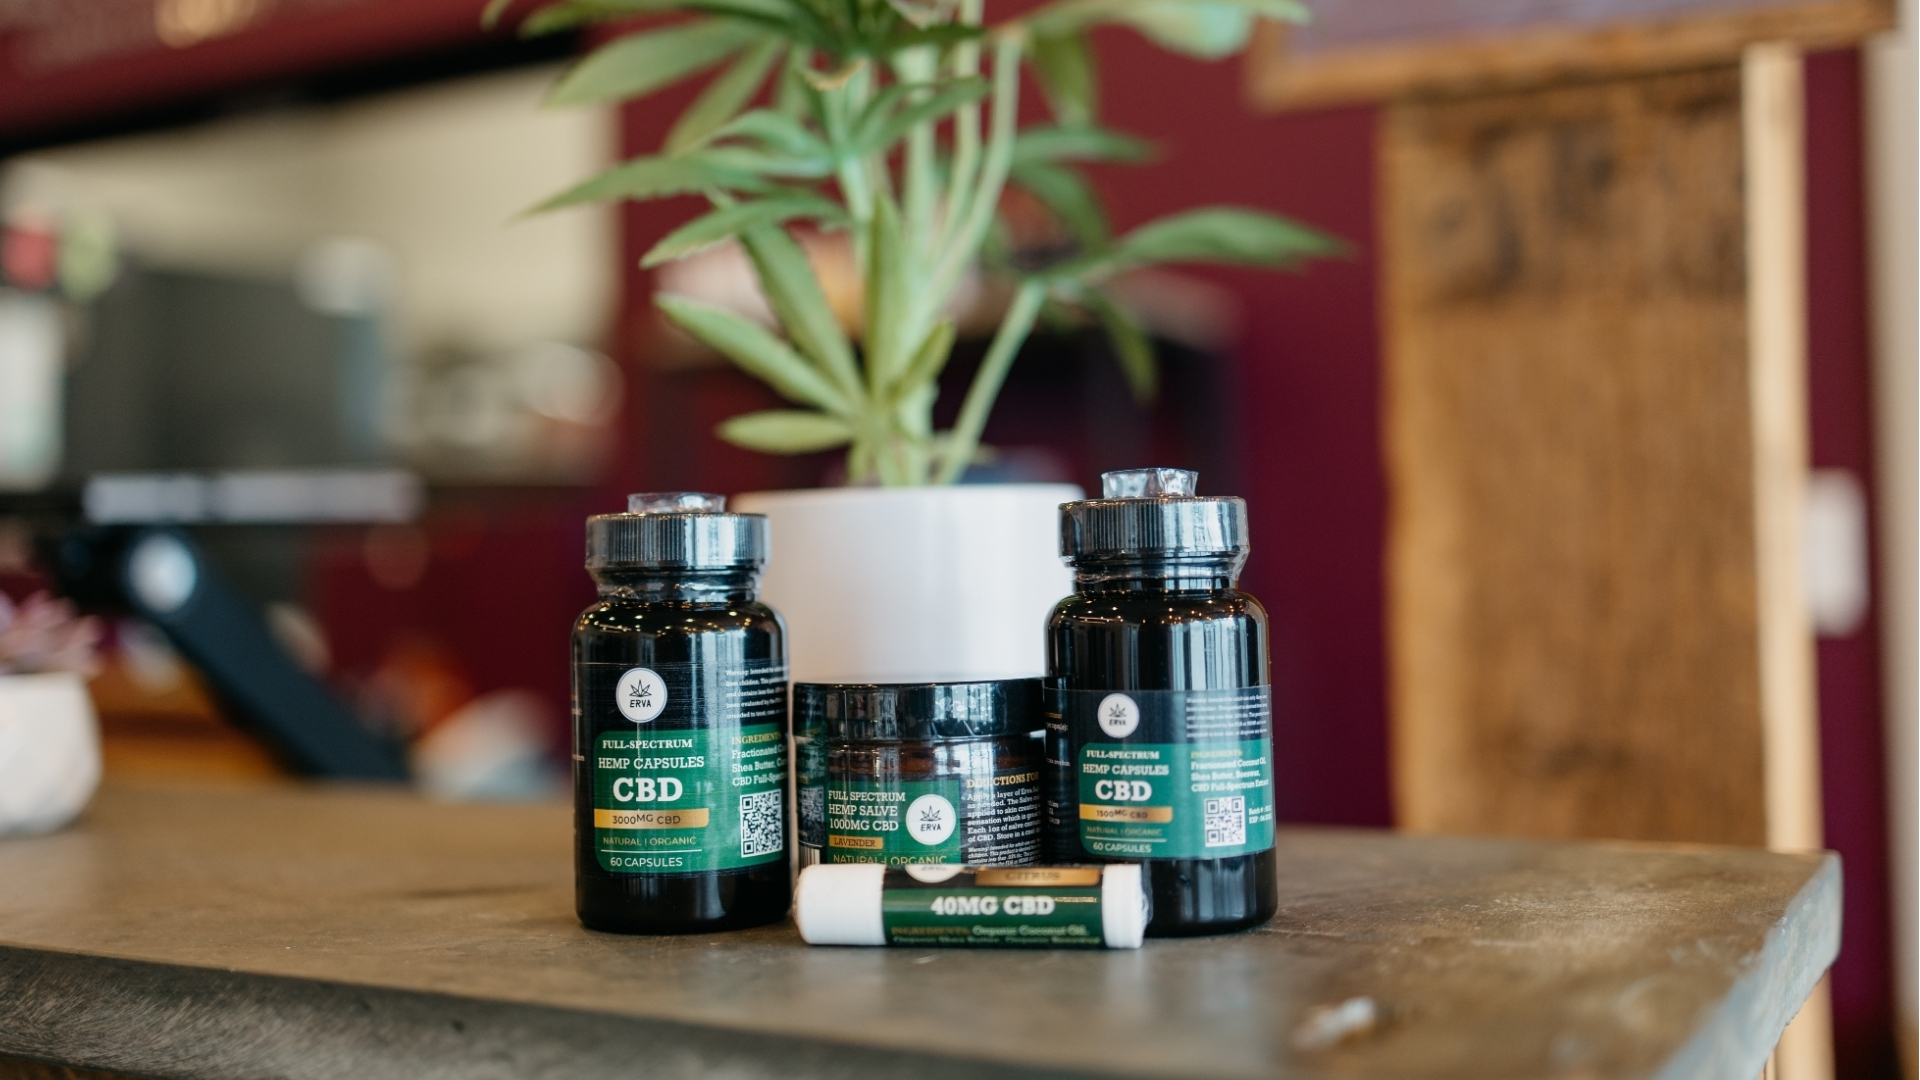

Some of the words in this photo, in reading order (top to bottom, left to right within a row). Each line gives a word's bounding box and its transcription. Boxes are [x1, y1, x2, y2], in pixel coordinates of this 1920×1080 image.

[630, 700, 652, 708] ERVA
[602, 739, 693, 749] FULL-SPECTRUM
[732, 744, 777, 759] Fractionated
[1086, 750, 1160, 760] FULL-SPECTRUM
[598, 758, 630, 769] HEMP
[634, 756, 705, 769] CAPSULES
[732, 764, 753, 773] Shea
[1082, 763, 1110, 774] HEMP
[1112, 764, 1170, 776] CAPSULES
[732, 776, 752, 787] CBD
[1191, 782, 1210, 792] CBD
[613, 777, 683, 802] CBD
[1095, 780, 1152, 801] CBD
[828, 790, 848, 800] FULL
[850, 792, 906, 802] SPECTRUM
[828, 804, 857, 815] HEMP
[859, 806, 898, 817] SALVE
[967, 809, 995, 818] applied
[1096, 810, 1128, 818] 1500MG
[1130, 812, 1148, 820] CBD
[612, 814, 654, 825] 3000MG
[657, 815, 681, 825] CBD
[830, 818, 870, 831] 1000MG
[872, 820, 899, 831] CBD
[967, 818, 1002, 826] sensation
[1003, 814, 1021, 822] which
[920, 824, 941, 832] ERVA
[1086, 826, 1119, 835] NATURAL
[1124, 828, 1162, 836] ORGANIC
[603, 837, 642, 846] NATURAL
[650, 836, 697, 846] ORGANIC
[996, 832, 1013, 840] Store
[834, 837, 876, 847] LAVENDER
[1093, 842, 1102, 850] 60
[1105, 843, 1152, 853] CAPSULES
[610, 857, 622, 867] 60
[624, 857, 683, 868] CAPSULES
[890, 855, 947, 866] ORGANIC
[1005, 871, 1060, 881] CITRUS
[930, 895, 999, 916] 40MG
[1003, 895, 1055, 916] CBD
[972, 925, 1017, 937] Organic
[1018, 924, 1066, 936] Coconut
